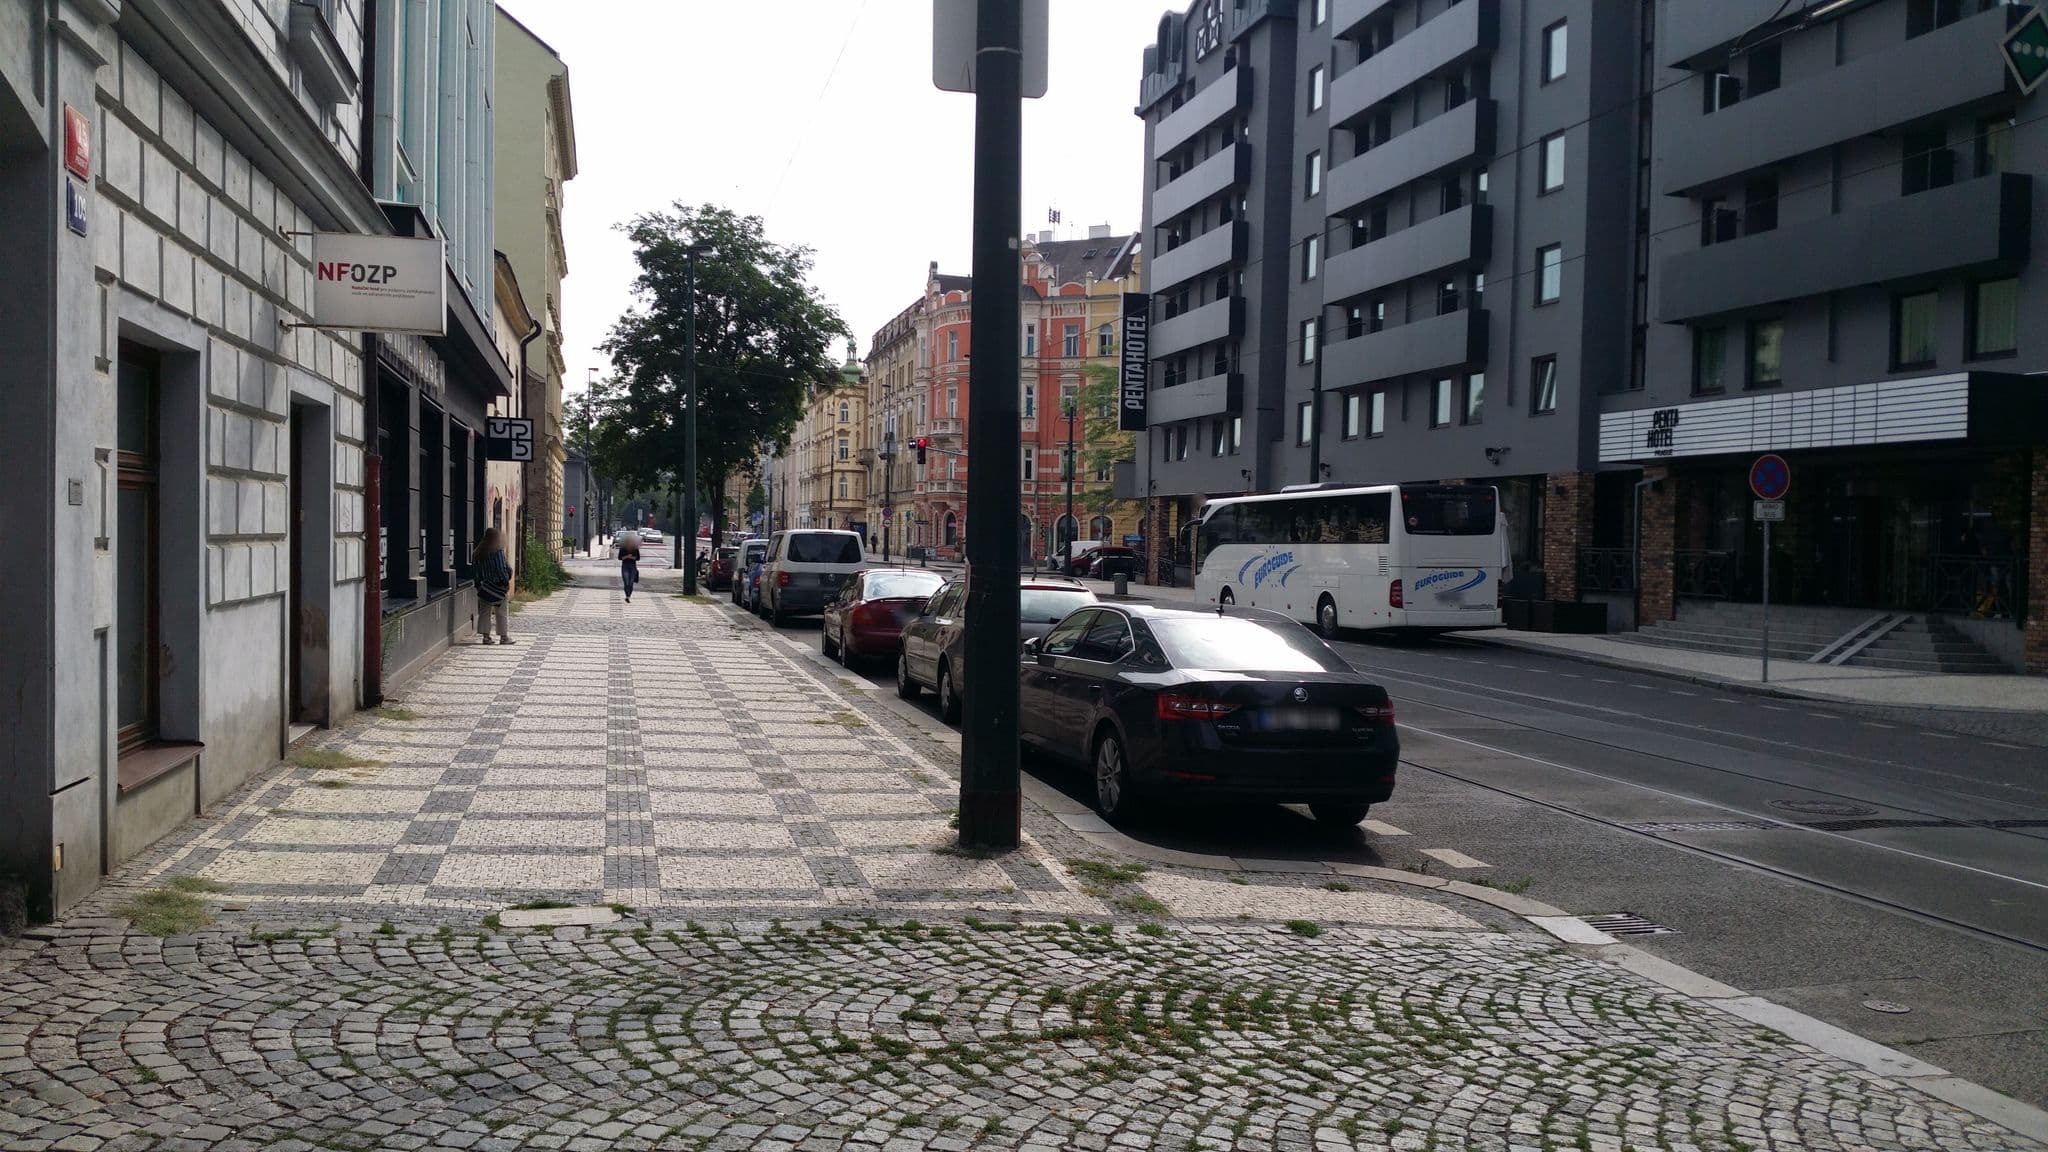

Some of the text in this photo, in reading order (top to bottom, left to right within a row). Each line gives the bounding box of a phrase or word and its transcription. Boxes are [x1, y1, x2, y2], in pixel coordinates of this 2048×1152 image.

[318, 261, 398, 285] NFOZP
[1125, 315, 1146, 411] PENTAHOTEL
[1653, 408, 1679, 429] PENTA
[1647, 428, 1673, 448] HOTEL
[1254, 551, 1294, 591] EUROGUIDE
[1415, 570, 1465, 592] EUROGUIDE
